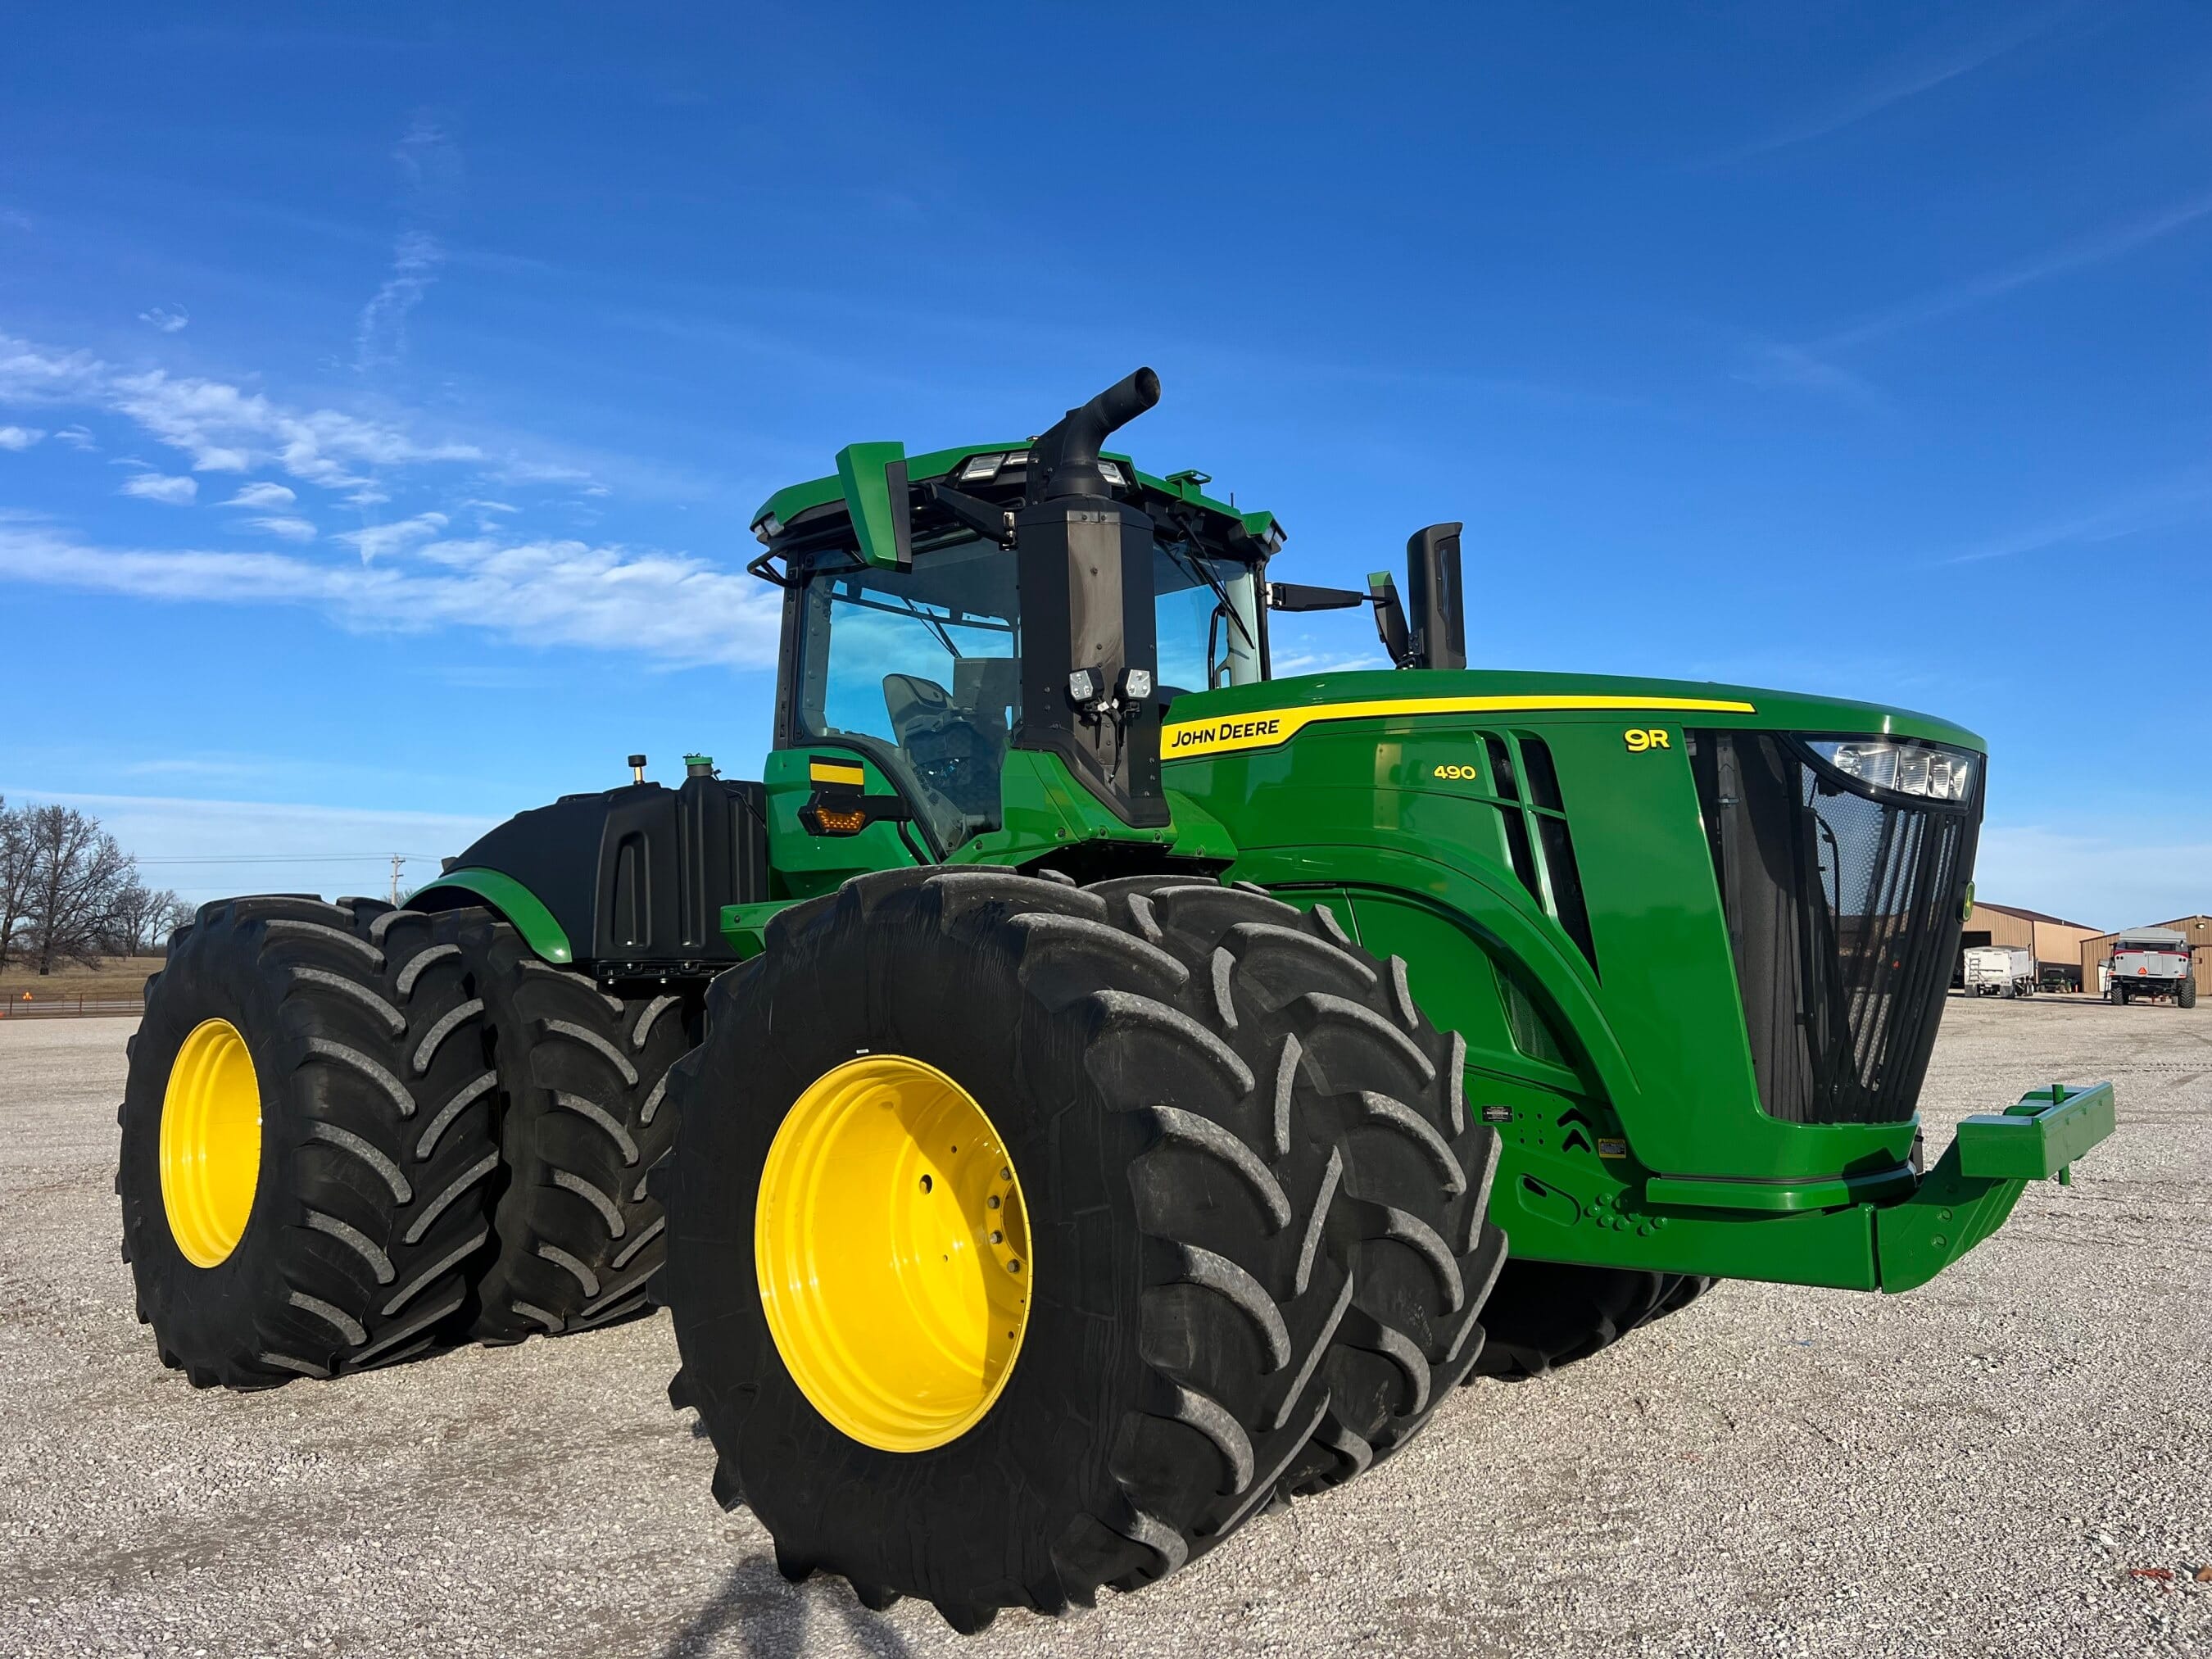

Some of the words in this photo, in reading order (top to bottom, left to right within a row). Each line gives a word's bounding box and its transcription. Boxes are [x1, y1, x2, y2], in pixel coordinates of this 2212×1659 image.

[1172, 728, 1216, 748] JOHN
[1219, 718, 1281, 741] DEERE
[1624, 728, 1671, 752] 9R
[1433, 764, 1477, 780] 490
